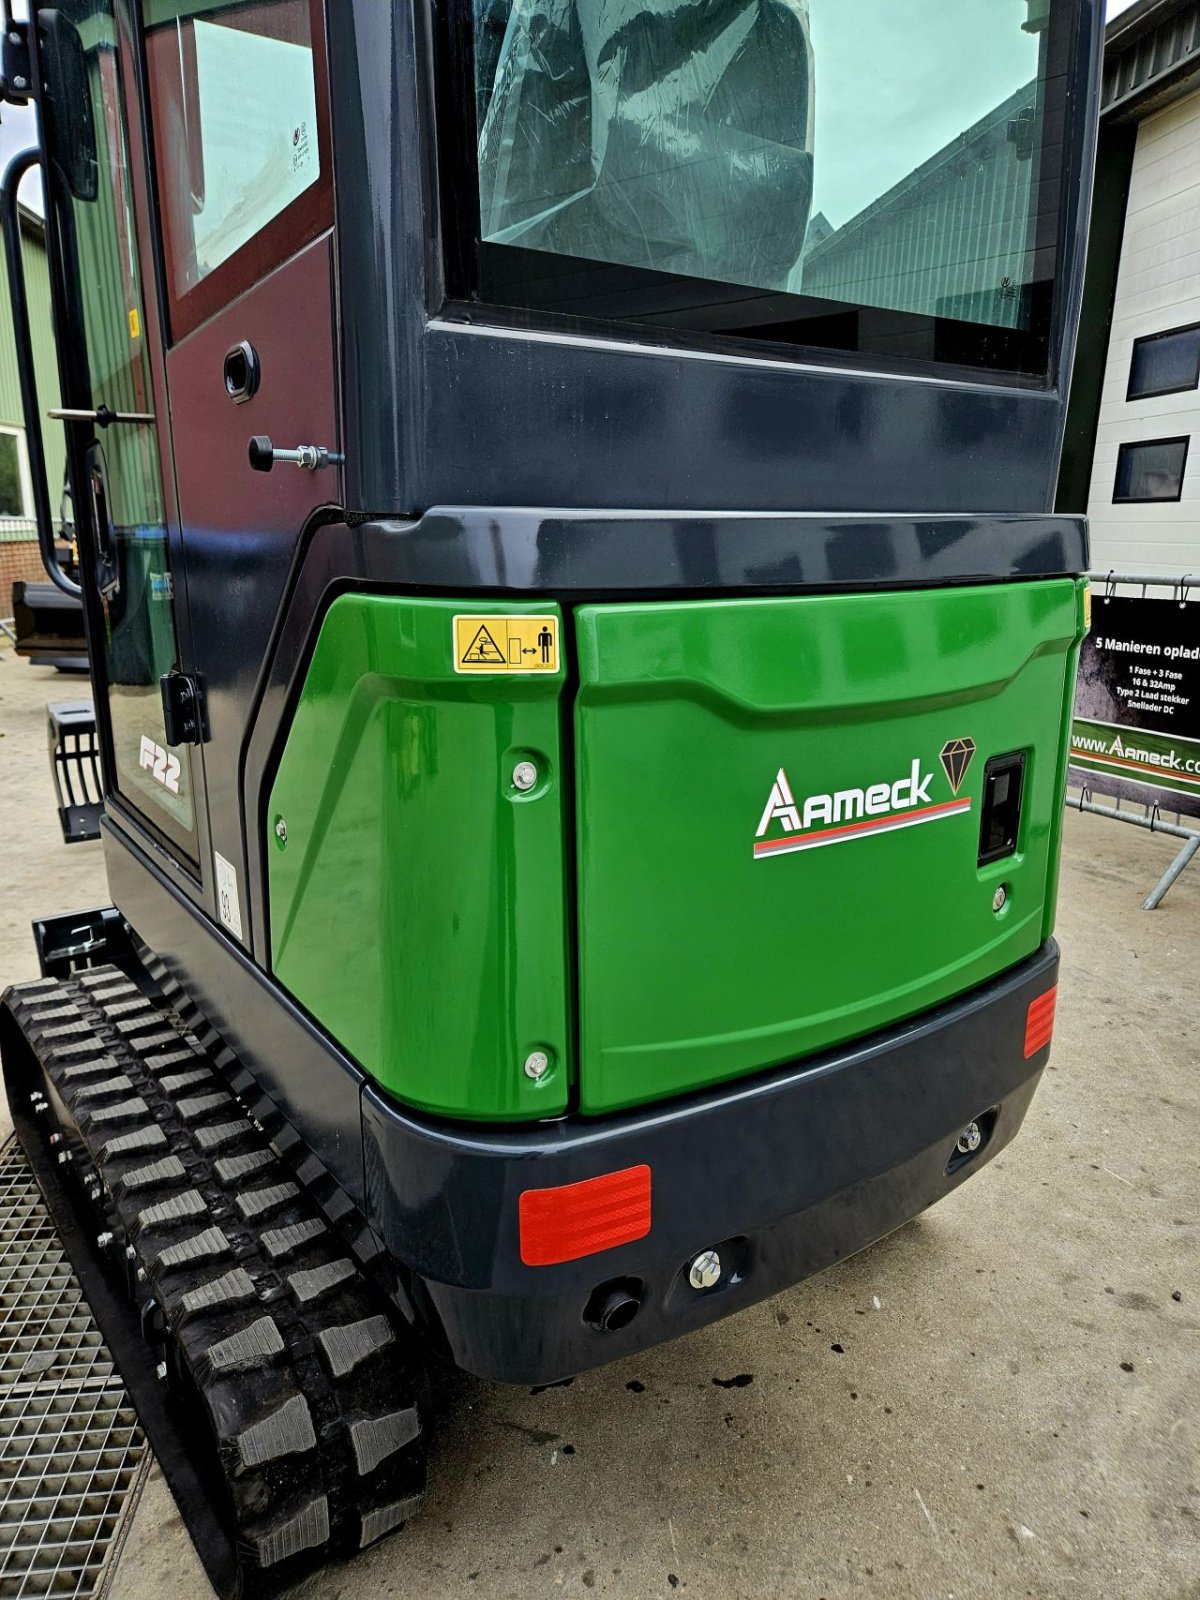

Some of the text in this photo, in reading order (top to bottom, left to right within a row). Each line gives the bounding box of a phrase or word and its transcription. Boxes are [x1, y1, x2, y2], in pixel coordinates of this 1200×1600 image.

[1096, 637, 1200, 660] 5 Manieren oplad
[1129, 665, 1134, 674] 1
[1134, 666, 1152, 676] Fase
[1158, 669, 1164, 677] 3
[1165, 670, 1183, 680] Fase
[1132, 677, 1176, 693] 16 & 32Amp
[1116, 686, 1189, 705] Type 2 Laad stekker
[1127, 699, 1175, 714] Snellader DC
[139, 735, 181, 794] F22
